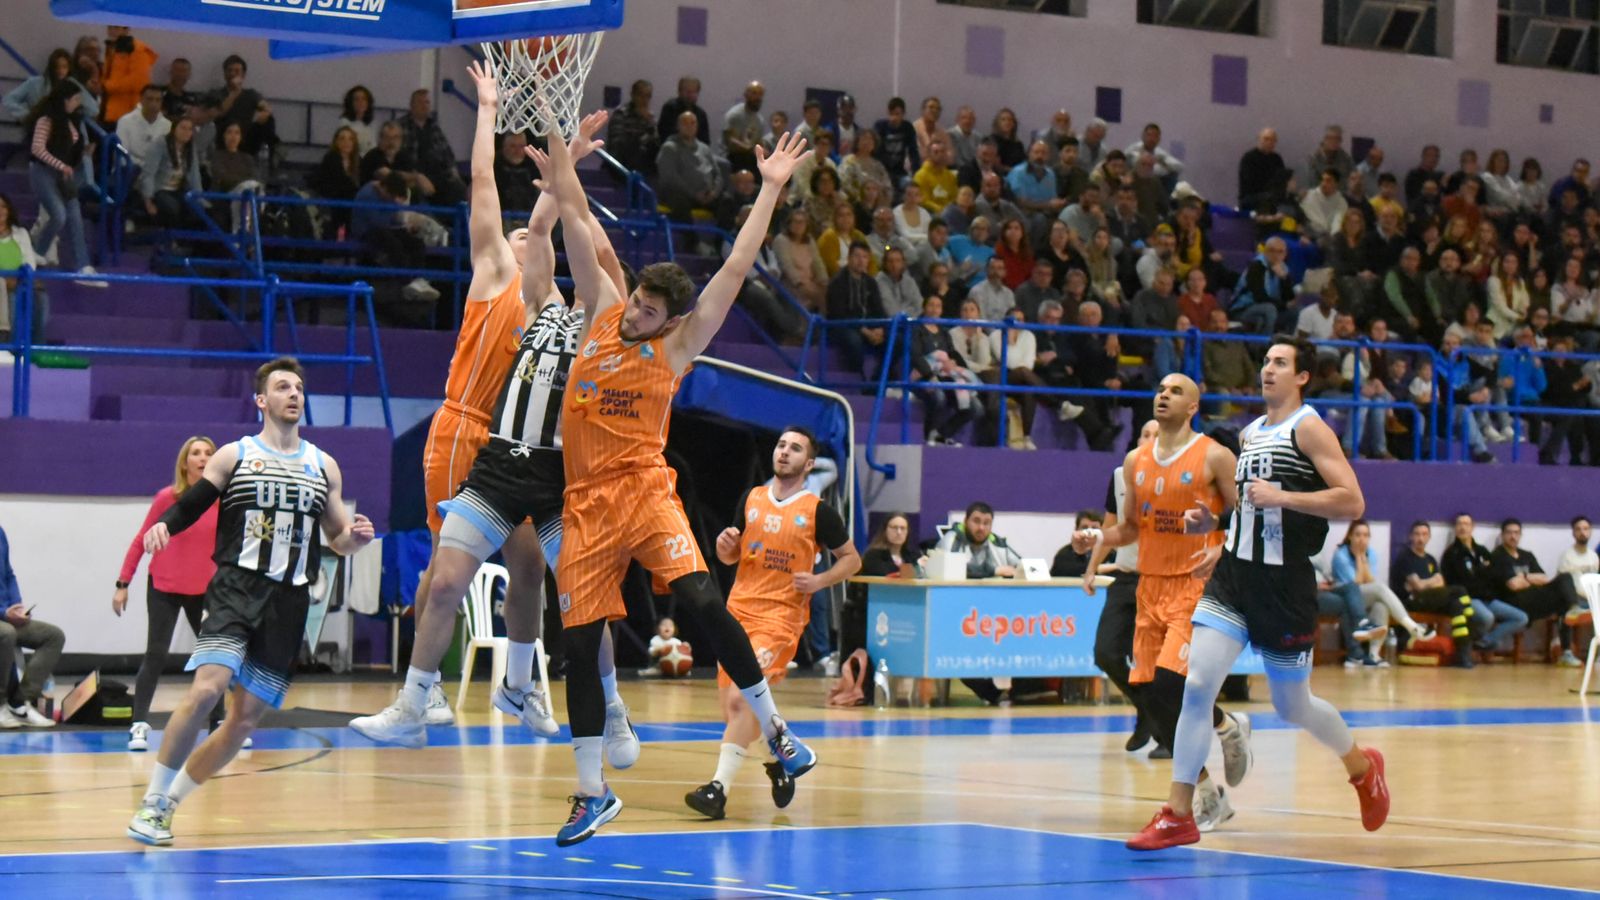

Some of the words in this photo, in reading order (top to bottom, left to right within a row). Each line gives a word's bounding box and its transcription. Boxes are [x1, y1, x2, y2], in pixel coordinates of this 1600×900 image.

[602, 388, 643, 399] MELILLA
[600, 397, 634, 407] SPORT
[599, 407, 640, 419] CAPITAL
[255, 481, 316, 513] ULB
[763, 513, 783, 534] 55
[665, 534, 693, 560] 22
[765, 548, 796, 560] MELILLA
[762, 564, 792, 575] CAPITAL
[961, 608, 1076, 643] deportes
